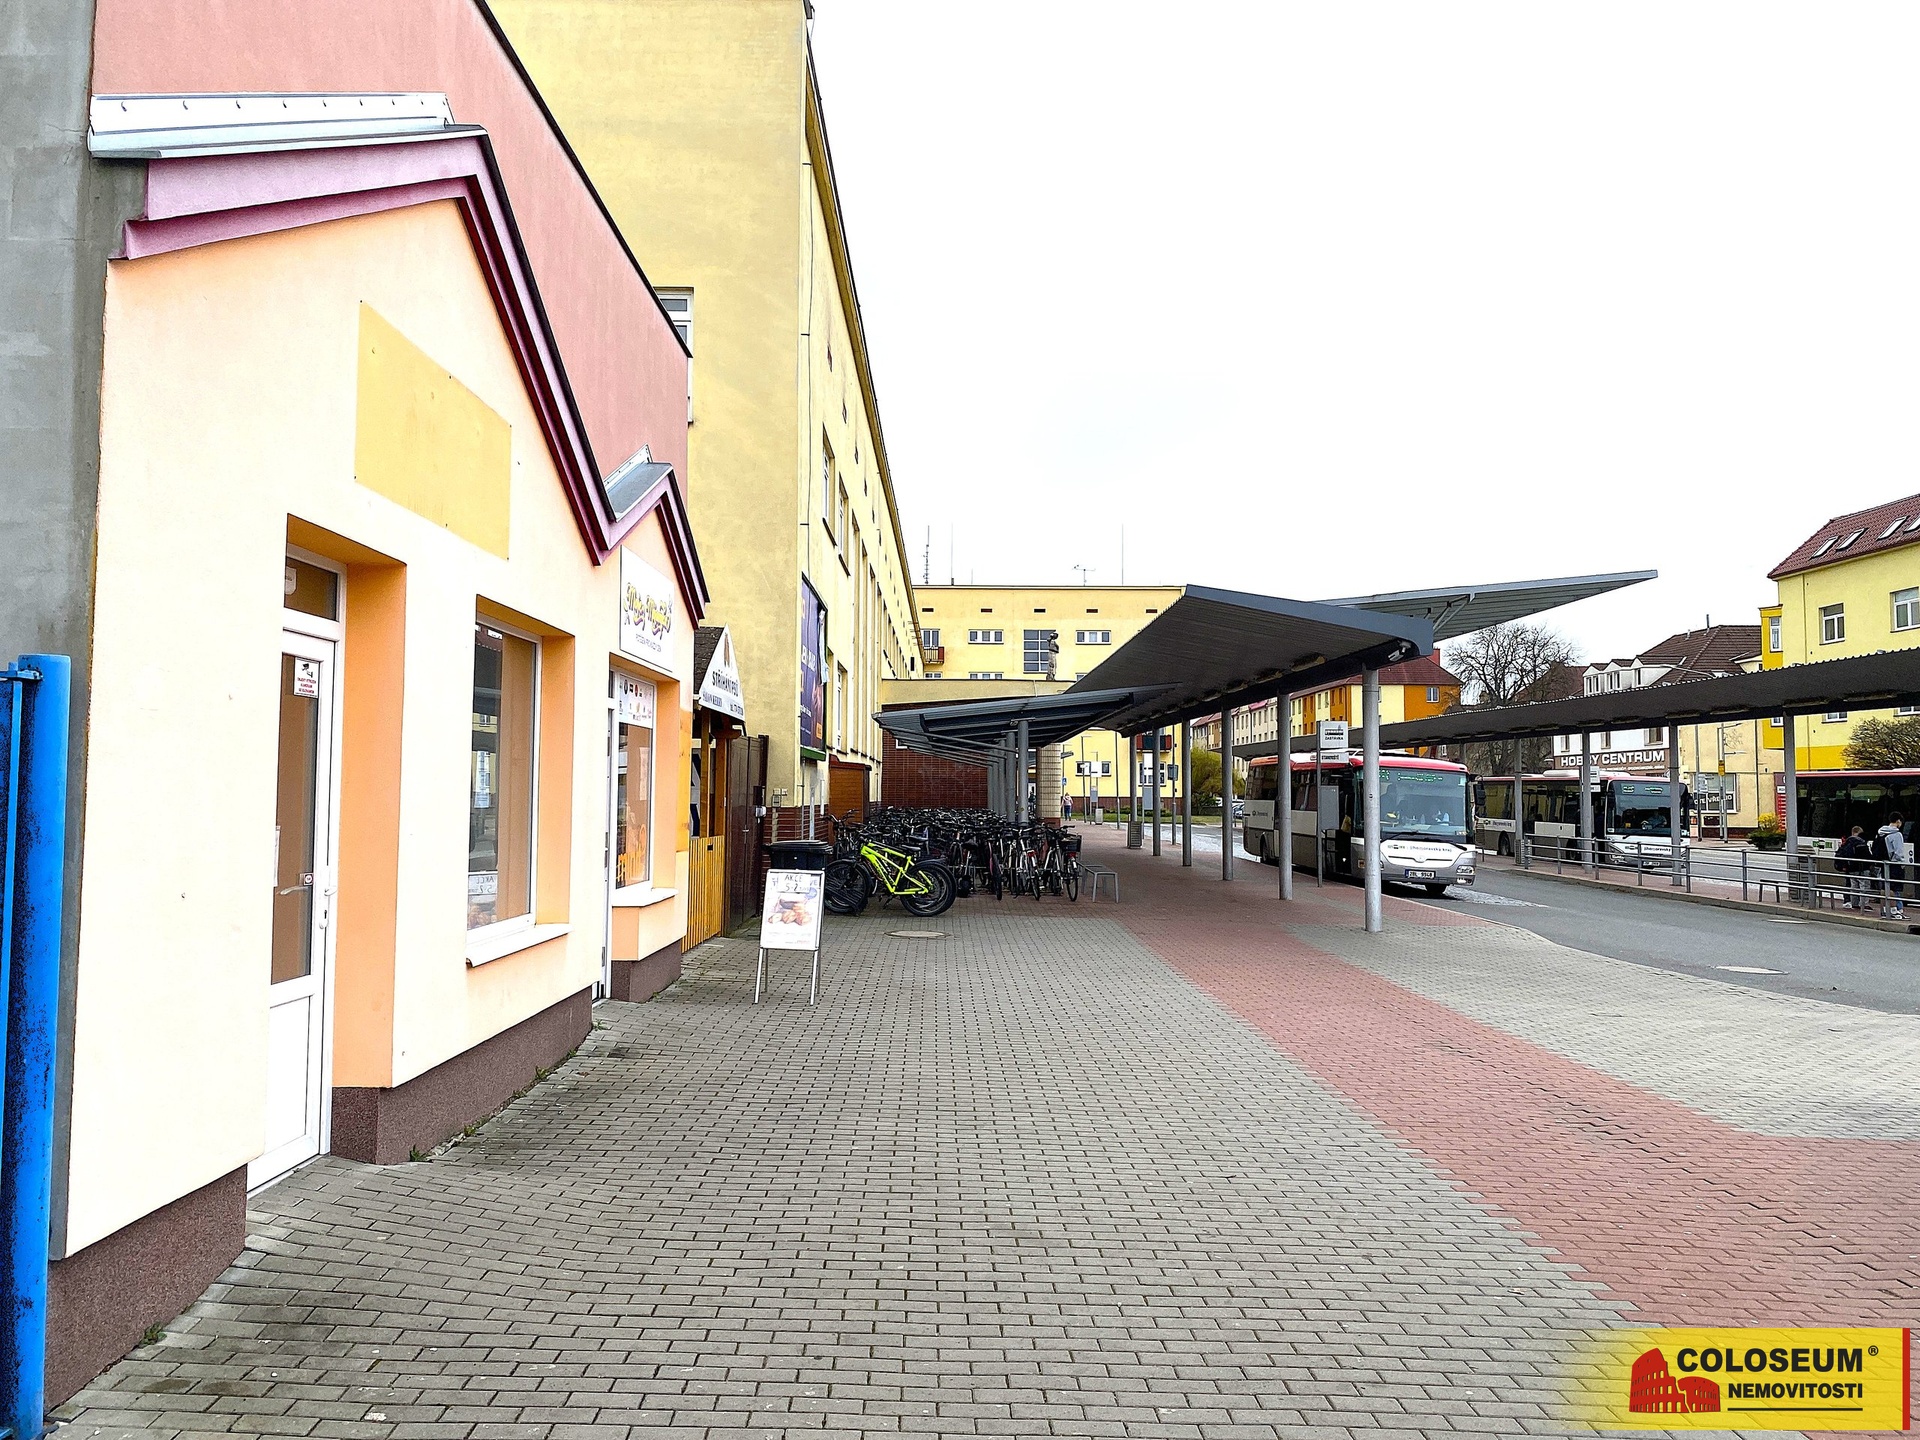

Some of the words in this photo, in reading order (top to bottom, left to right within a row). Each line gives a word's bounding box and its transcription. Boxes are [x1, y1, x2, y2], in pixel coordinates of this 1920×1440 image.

[1560, 754, 1600, 767] HOBY
[1601, 750, 1665, 765] CENTRUM
[784, 874, 804, 883] AKCE
